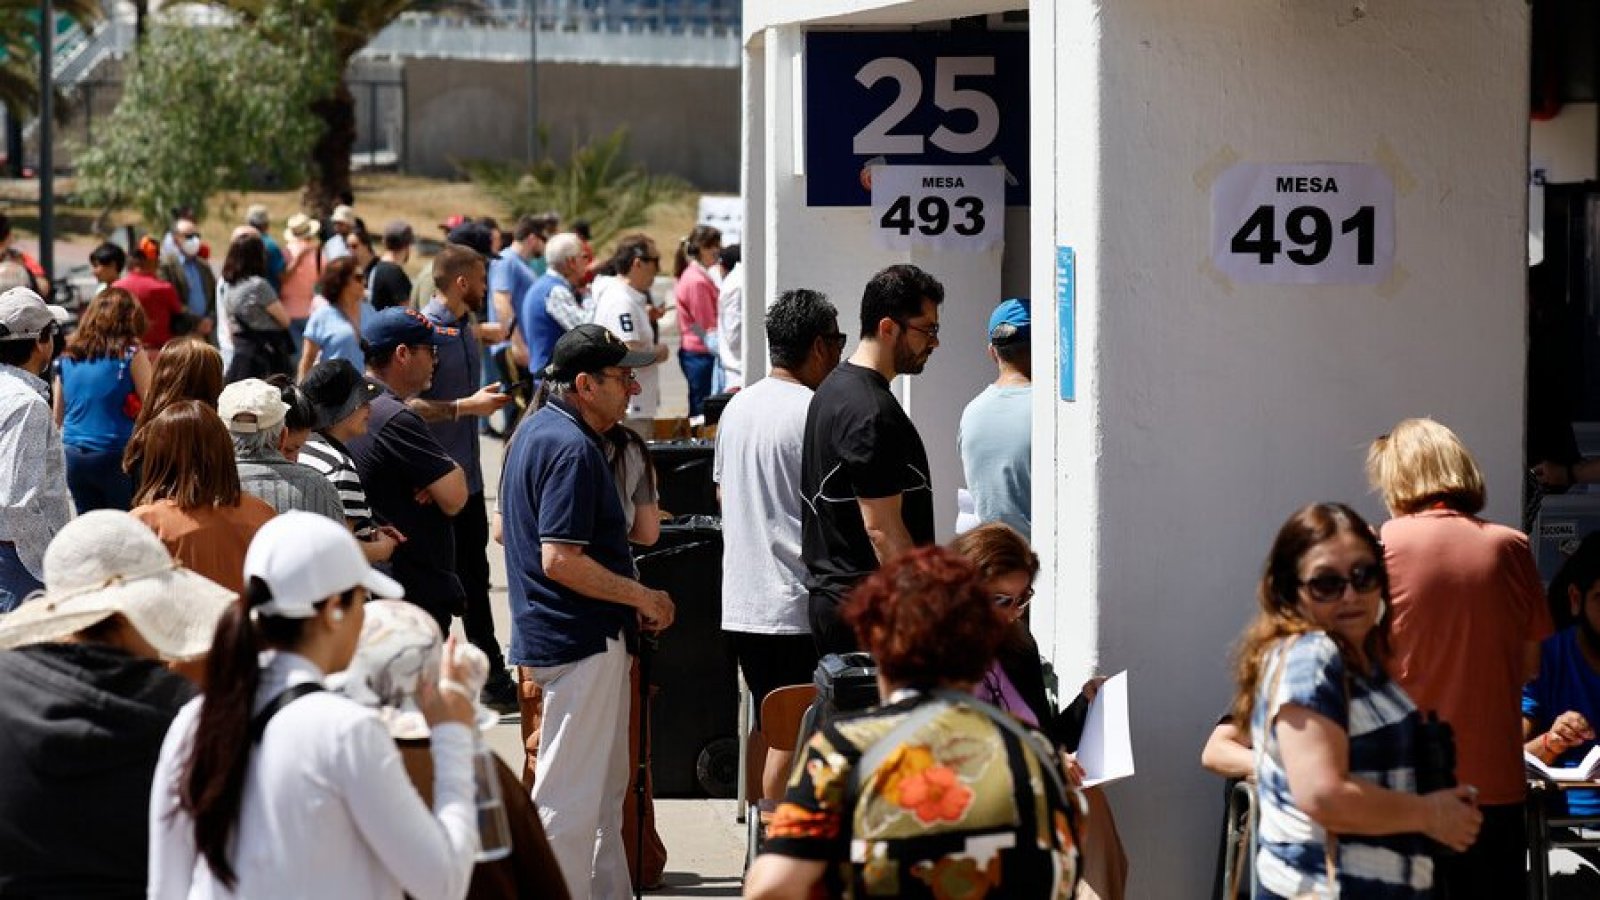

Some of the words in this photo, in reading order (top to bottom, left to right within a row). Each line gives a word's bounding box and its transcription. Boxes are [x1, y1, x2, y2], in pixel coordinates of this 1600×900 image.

[853, 56, 1000, 154] 25
[922, 177, 965, 188] MESA
[1276, 177, 1339, 193] MESA
[879, 195, 986, 236] 493
[1231, 205, 1375, 266] 491
[619, 312, 634, 332] 6
